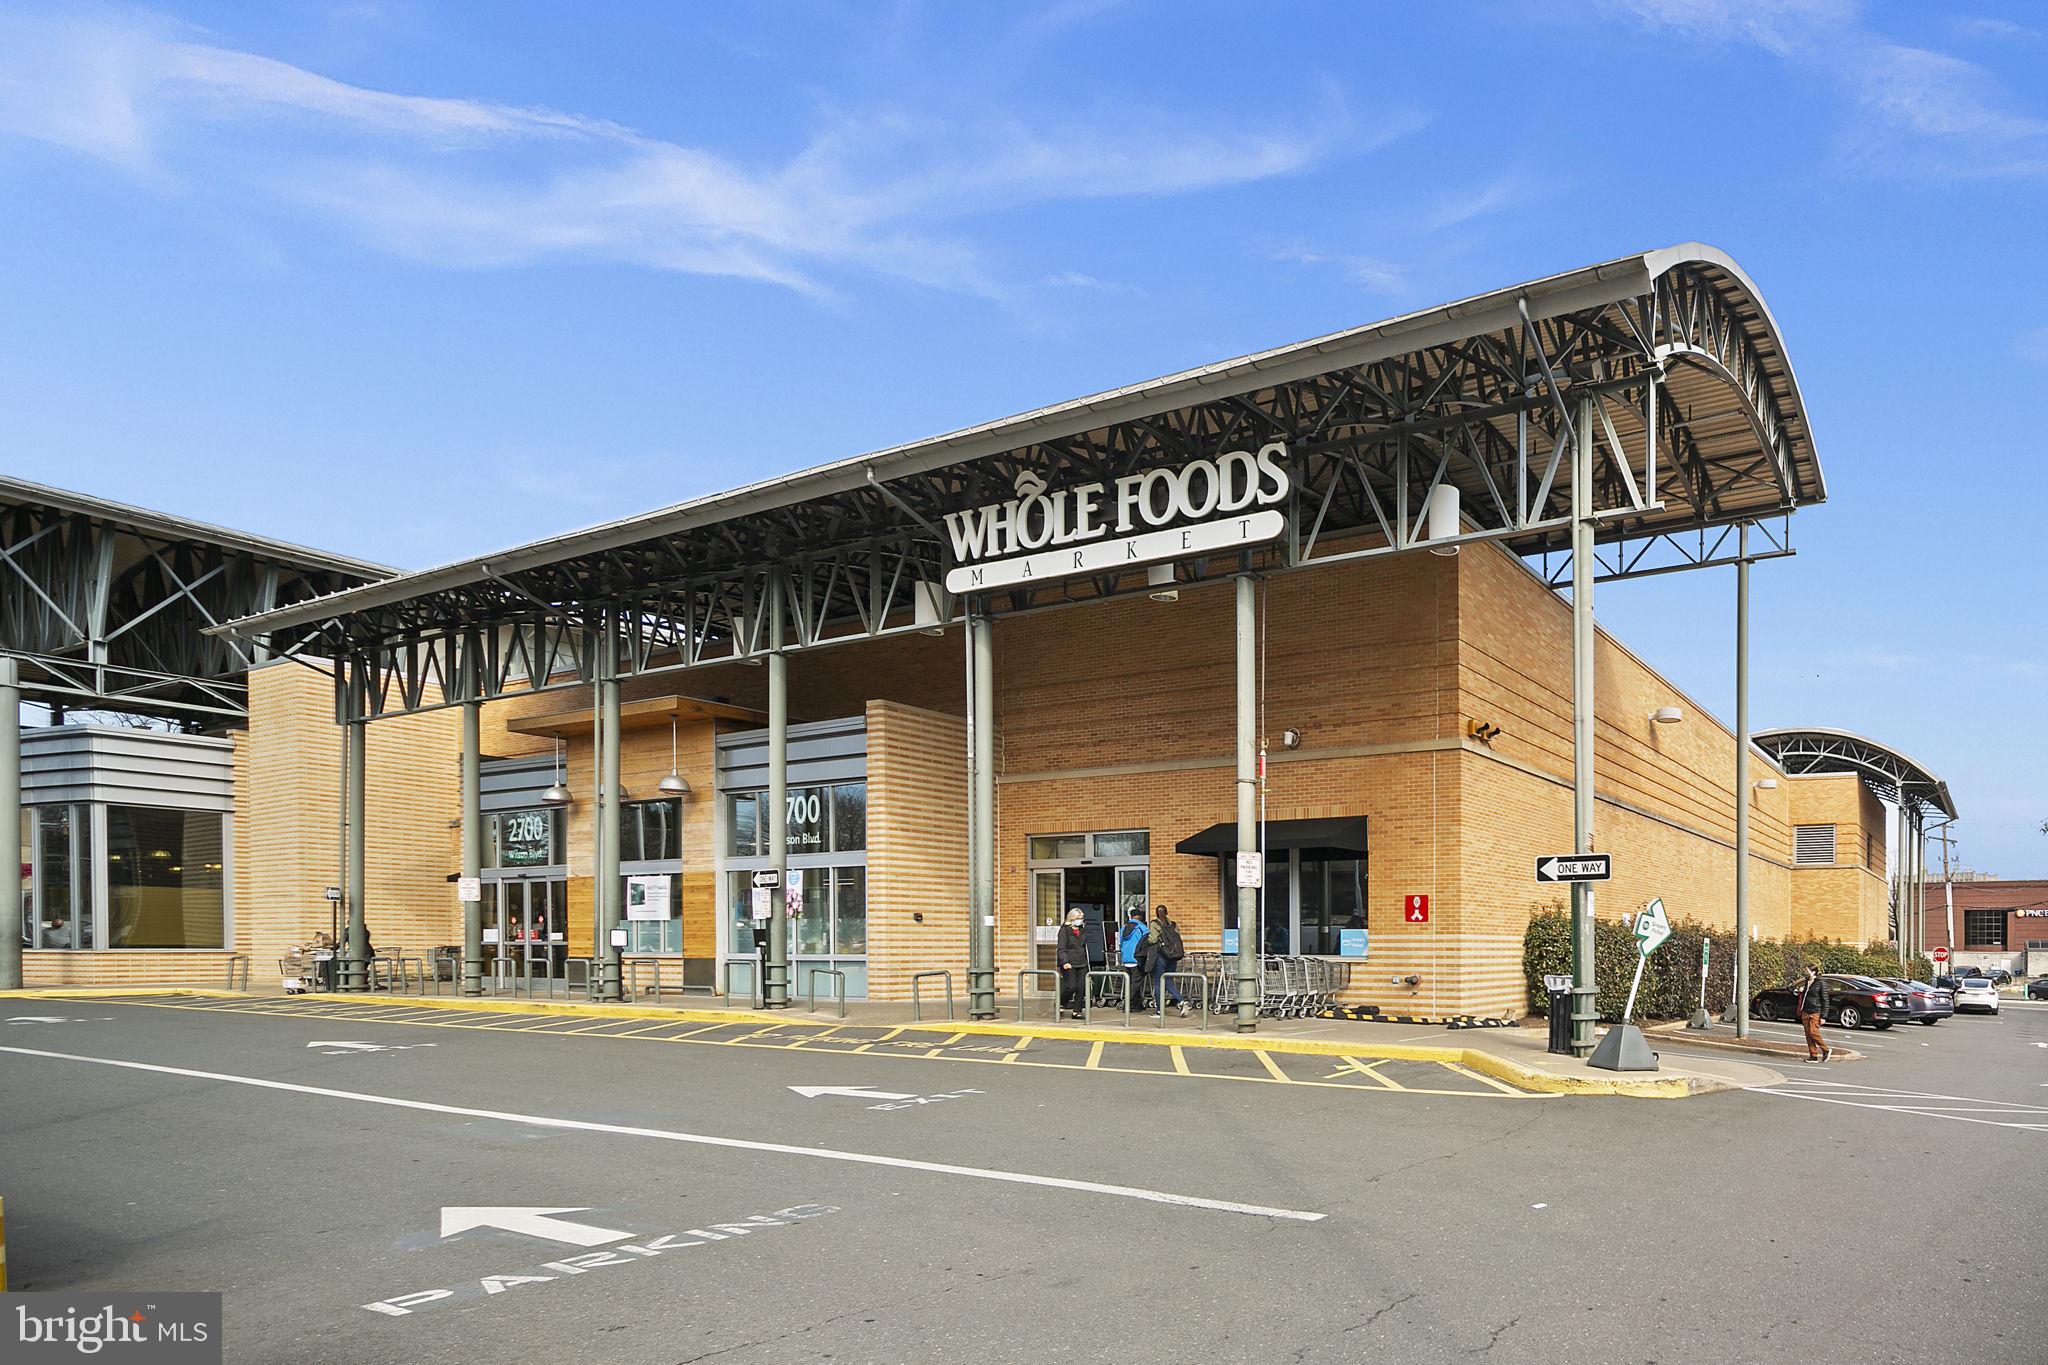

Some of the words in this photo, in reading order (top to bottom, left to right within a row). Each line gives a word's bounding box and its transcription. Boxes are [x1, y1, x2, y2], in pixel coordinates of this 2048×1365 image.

[943, 471, 1107, 562] WHOLE
[1115, 442, 1290, 533] FOODS
[971, 519, 1251, 586] MARKET
[786, 795, 820, 824] 700
[508, 816, 543, 842] 2700
[1558, 863, 1578, 874] ONE
[1581, 862, 1602, 873] WAY
[2025, 909, 2044, 917] PNC
[866, 1089, 986, 1110] EXIT
[359, 1203, 842, 1316] PARKING
